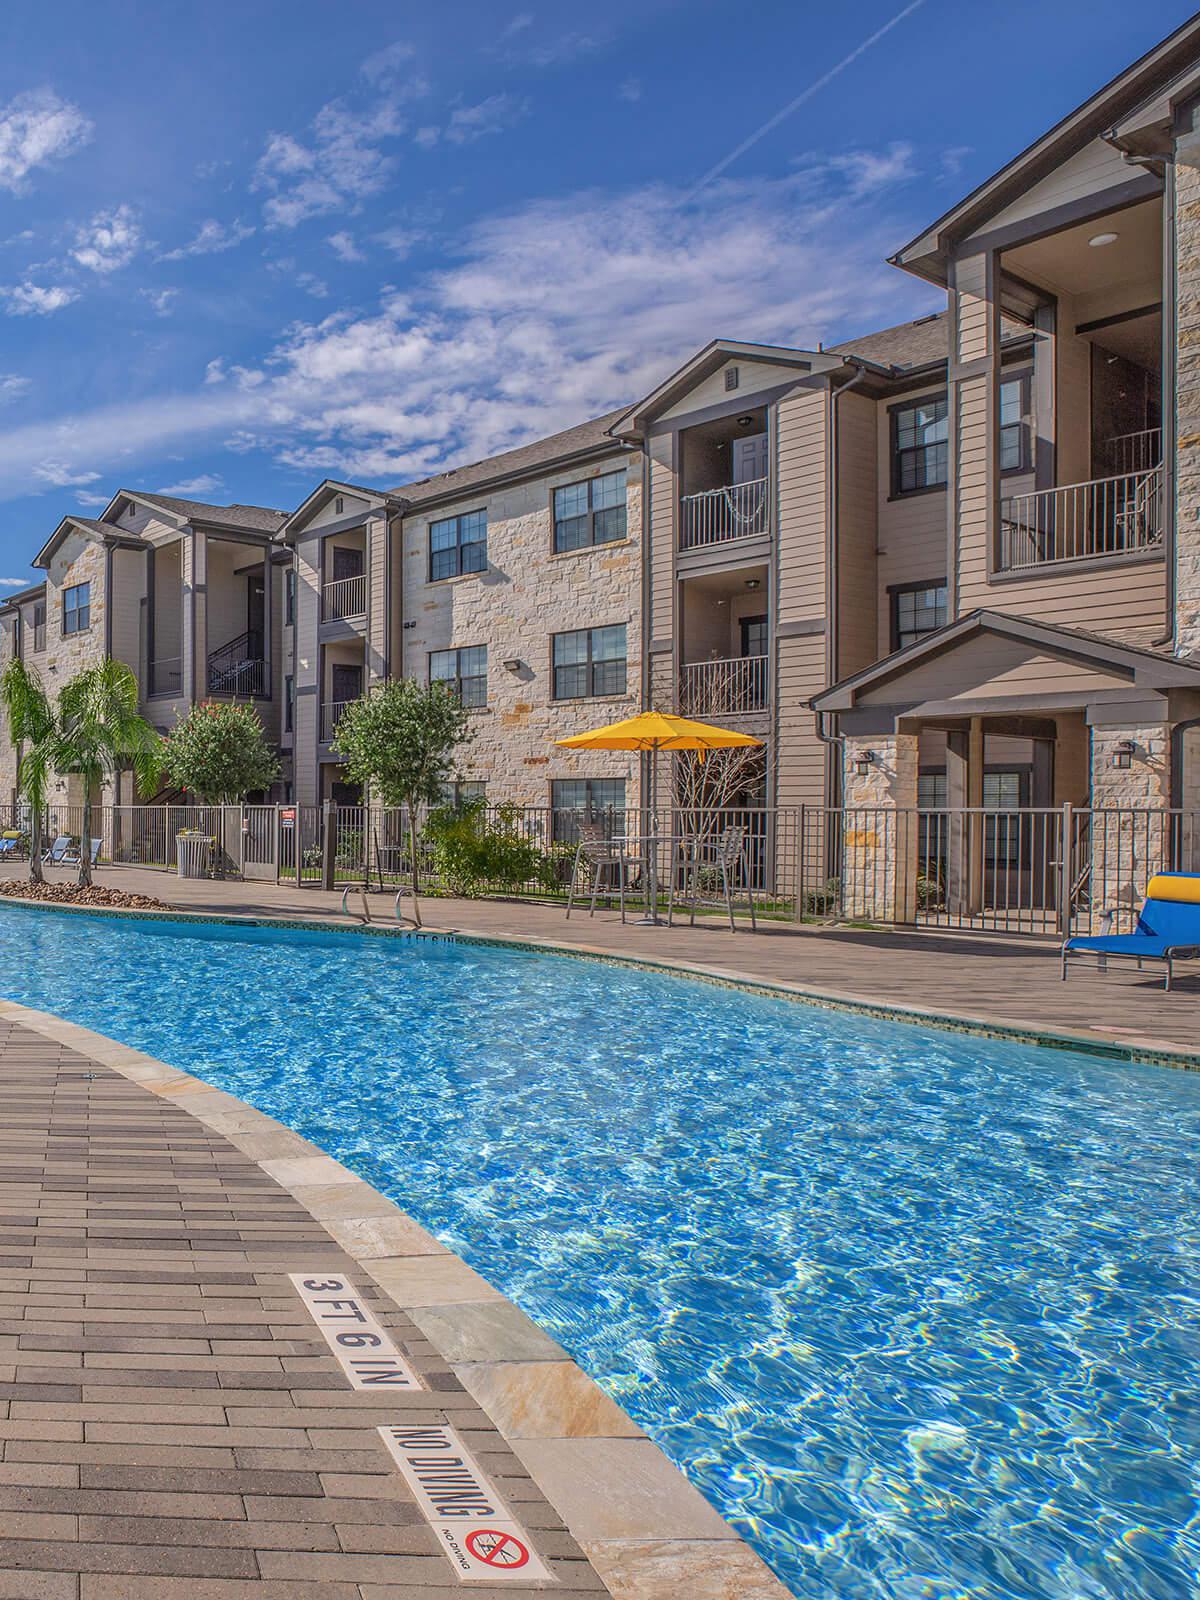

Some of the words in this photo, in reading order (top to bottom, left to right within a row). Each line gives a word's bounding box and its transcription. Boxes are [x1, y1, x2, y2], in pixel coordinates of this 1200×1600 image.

[303, 1280, 344, 1291] 3
[313, 1300, 367, 1322] FT
[335, 1333, 381, 1347] 6
[350, 1361, 410, 1384] IN
[390, 1429, 452, 1448] NO
[406, 1457, 495, 1516] DIVING
[441, 1528, 453, 1542] NO
[449, 1543, 471, 1570] DIVING
